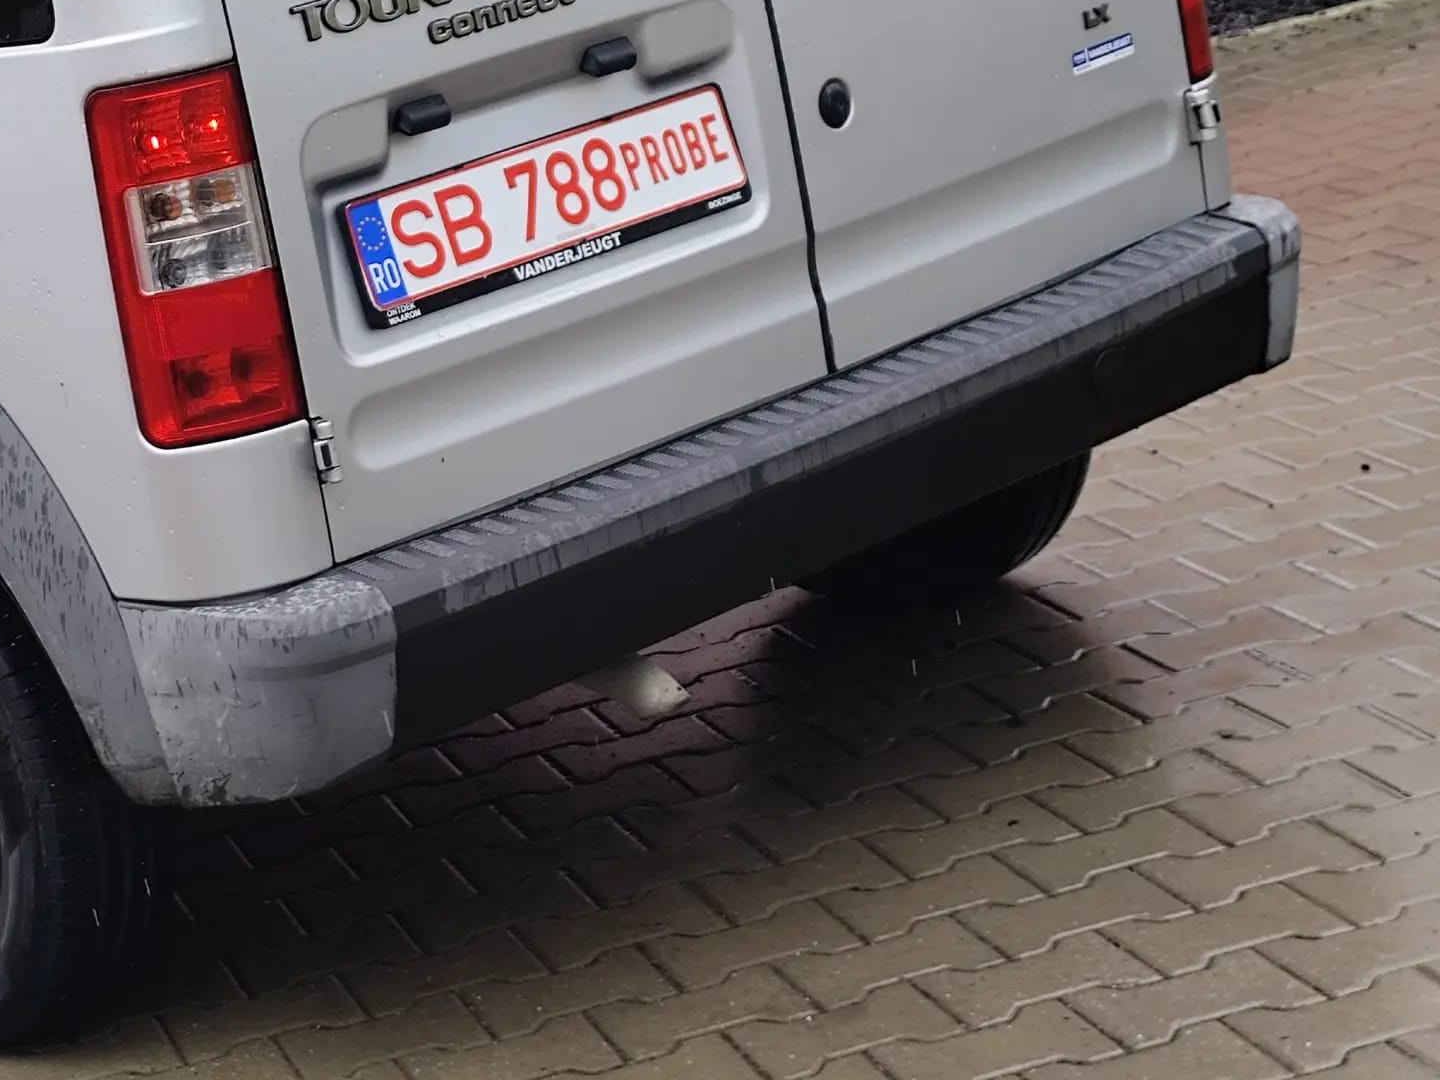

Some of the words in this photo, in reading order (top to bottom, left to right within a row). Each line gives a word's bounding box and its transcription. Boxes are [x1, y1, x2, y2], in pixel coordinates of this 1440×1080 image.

[1082, 3, 1111, 30] LX
[390, 185, 492, 278] SB
[514, 231, 622, 281] VANDERJEUGT
[368, 258, 401, 294] RO
[387, 301, 417, 318] ONTDEK
[388, 308, 422, 326] WAAROM
